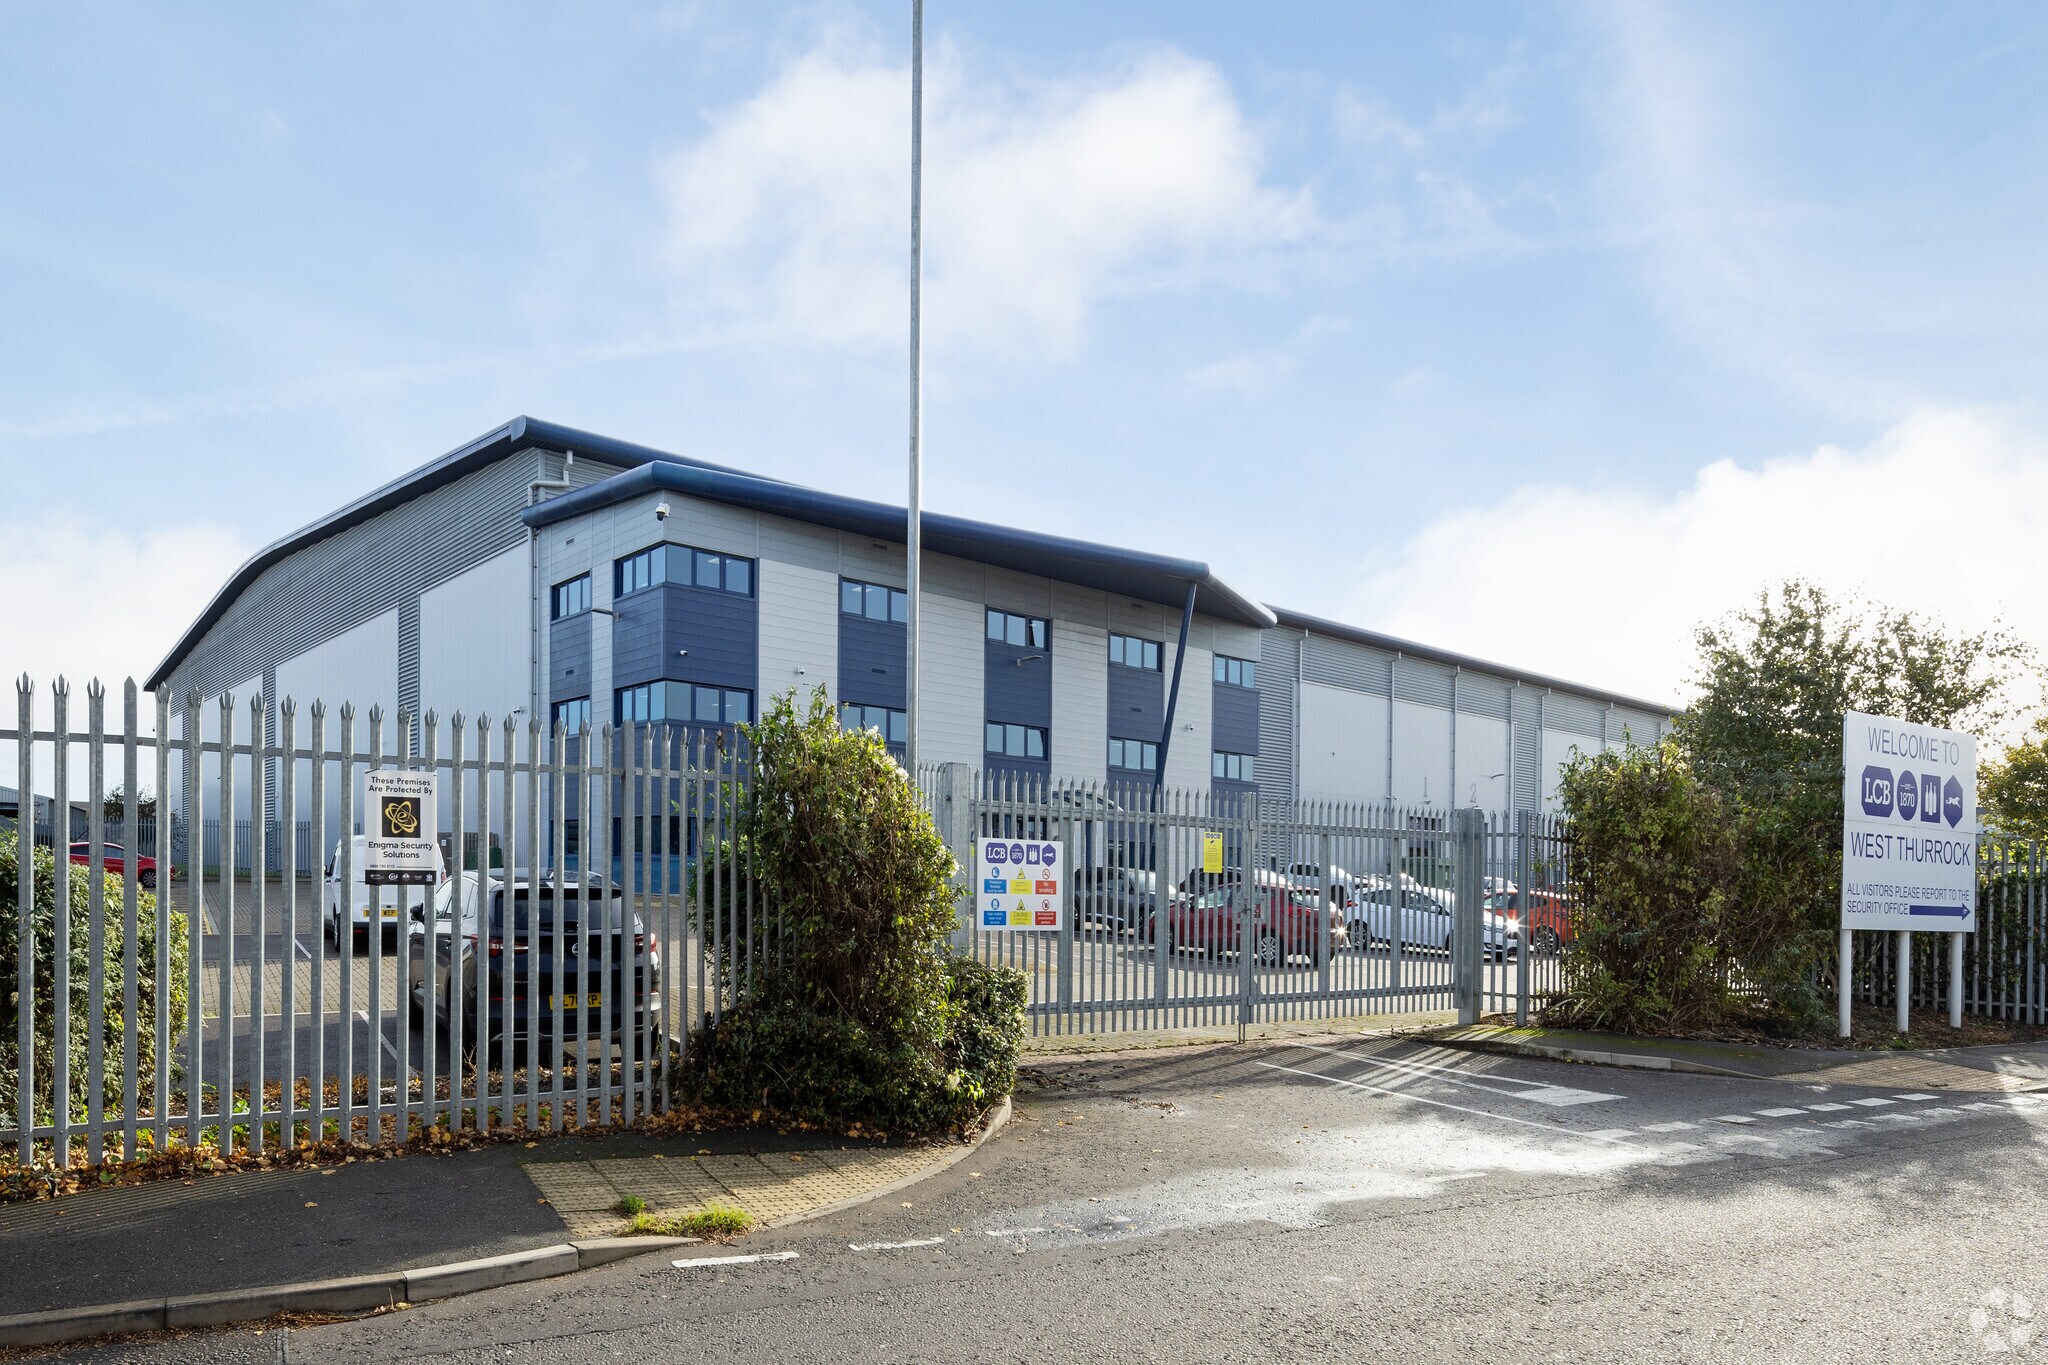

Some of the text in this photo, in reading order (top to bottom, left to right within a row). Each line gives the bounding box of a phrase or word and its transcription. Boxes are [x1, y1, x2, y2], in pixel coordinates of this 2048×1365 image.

[1868, 726, 1959, 765] WELCOME TO
[371, 776, 431, 786] These Premises
[386, 785, 421, 794] Protected
[424, 787, 433, 795] By
[1470, 782, 1477, 803] 2
[1865, 777, 1891, 805] LCB
[1899, 792, 1915, 807] 1870
[368, 841, 433, 851] Enigma Security
[988, 848, 1005, 858] LCB
[1851, 831, 1971, 866] WEST THURROCK
[383, 851, 420, 859] Solutions
[1847, 882, 1969, 902] ALL VISITORS PLEASE REPORT TO THE
[1847, 900, 1908, 915] SECURITY OFFICE
